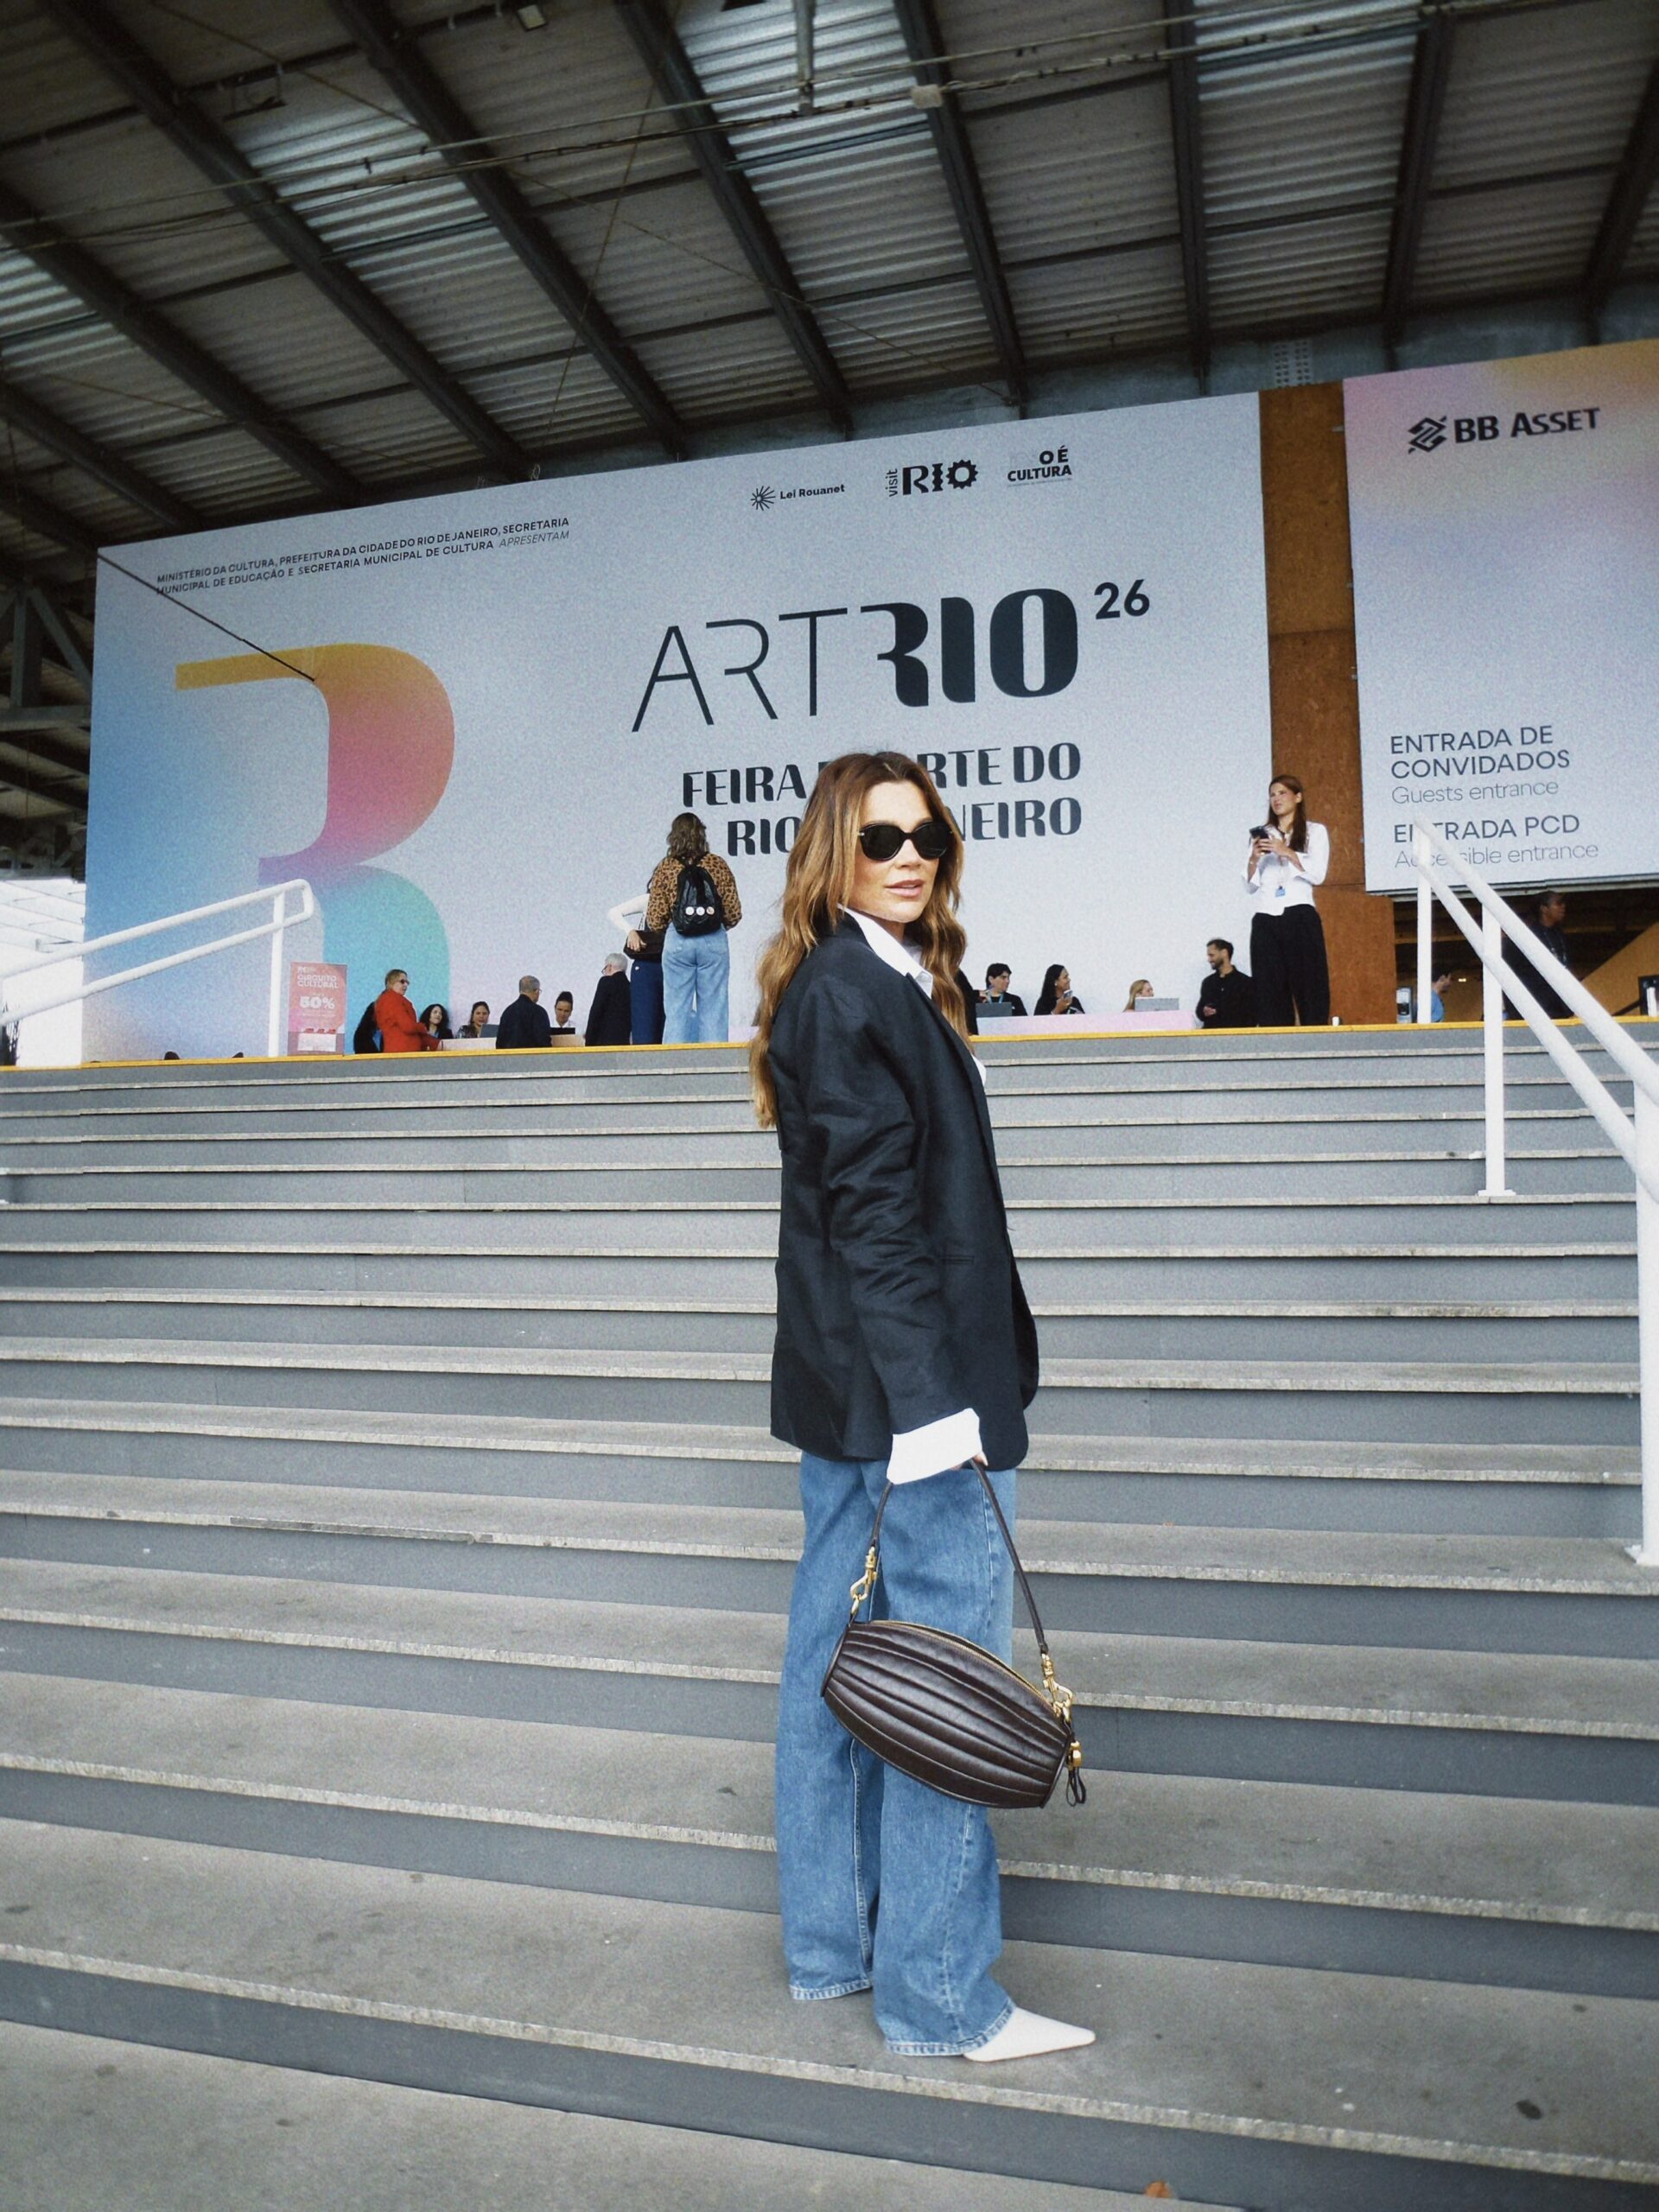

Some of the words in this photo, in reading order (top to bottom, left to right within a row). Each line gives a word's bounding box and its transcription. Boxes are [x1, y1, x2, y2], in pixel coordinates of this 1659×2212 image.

[1454, 416, 1500, 443] BB
[1510, 407, 1600, 437] ASSET
[886, 468, 898, 498] visit
[902, 459, 979, 496] RIO
[1007, 464, 1072, 482] CULTURA
[780, 489, 796, 499] Lei
[798, 484, 845, 498] Rouanet
[157, 567, 212, 582] MINISTÉRIO
[213, 566, 226, 575] DA
[228, 558, 278, 573] CULTURA,
[280, 549, 340, 565] PREFEITURA
[342, 547, 357, 556] DA
[359, 540, 398, 554] CIDADE
[400, 538, 416, 548] DO
[417, 536, 435, 546] RIO
[437, 533, 450, 543] DE
[452, 527, 501, 542] JANEIRO,
[503, 518, 569, 535] SECRETARIA
[157, 581, 210, 594] MUNICIPAL
[213, 577, 226, 588] DE
[229, 568, 285, 585] EDUCAÇÃO
[288, 568, 294, 577] E
[298, 558, 360, 575] SECRETARIA
[364, 550, 422, 566] MUNICIPAL
[426, 548, 440, 557] DE
[442, 541, 493, 555] CULTURA
[499, 531, 569, 548] APRESENTAM
[1094, 579, 1151, 620] 26
[1390, 728, 1512, 754] ENTRADA
[1521, 725, 1554, 746] DE
[683, 764, 807, 808] FEIRA
[917, 747, 1002, 789] RTE
[1013, 742, 1081, 784] DO
[1391, 749, 1570, 779] CONVIDADOS
[1392, 785, 1464, 804] Guests
[1469, 780, 1559, 800] entrance
[728, 816, 802, 857] RIO
[945, 797, 1082, 842] NEIRO
[1525, 815, 1580, 837] PCD
[1395, 847, 1502, 868] Aeible
[1508, 842, 1599, 863] entrance
